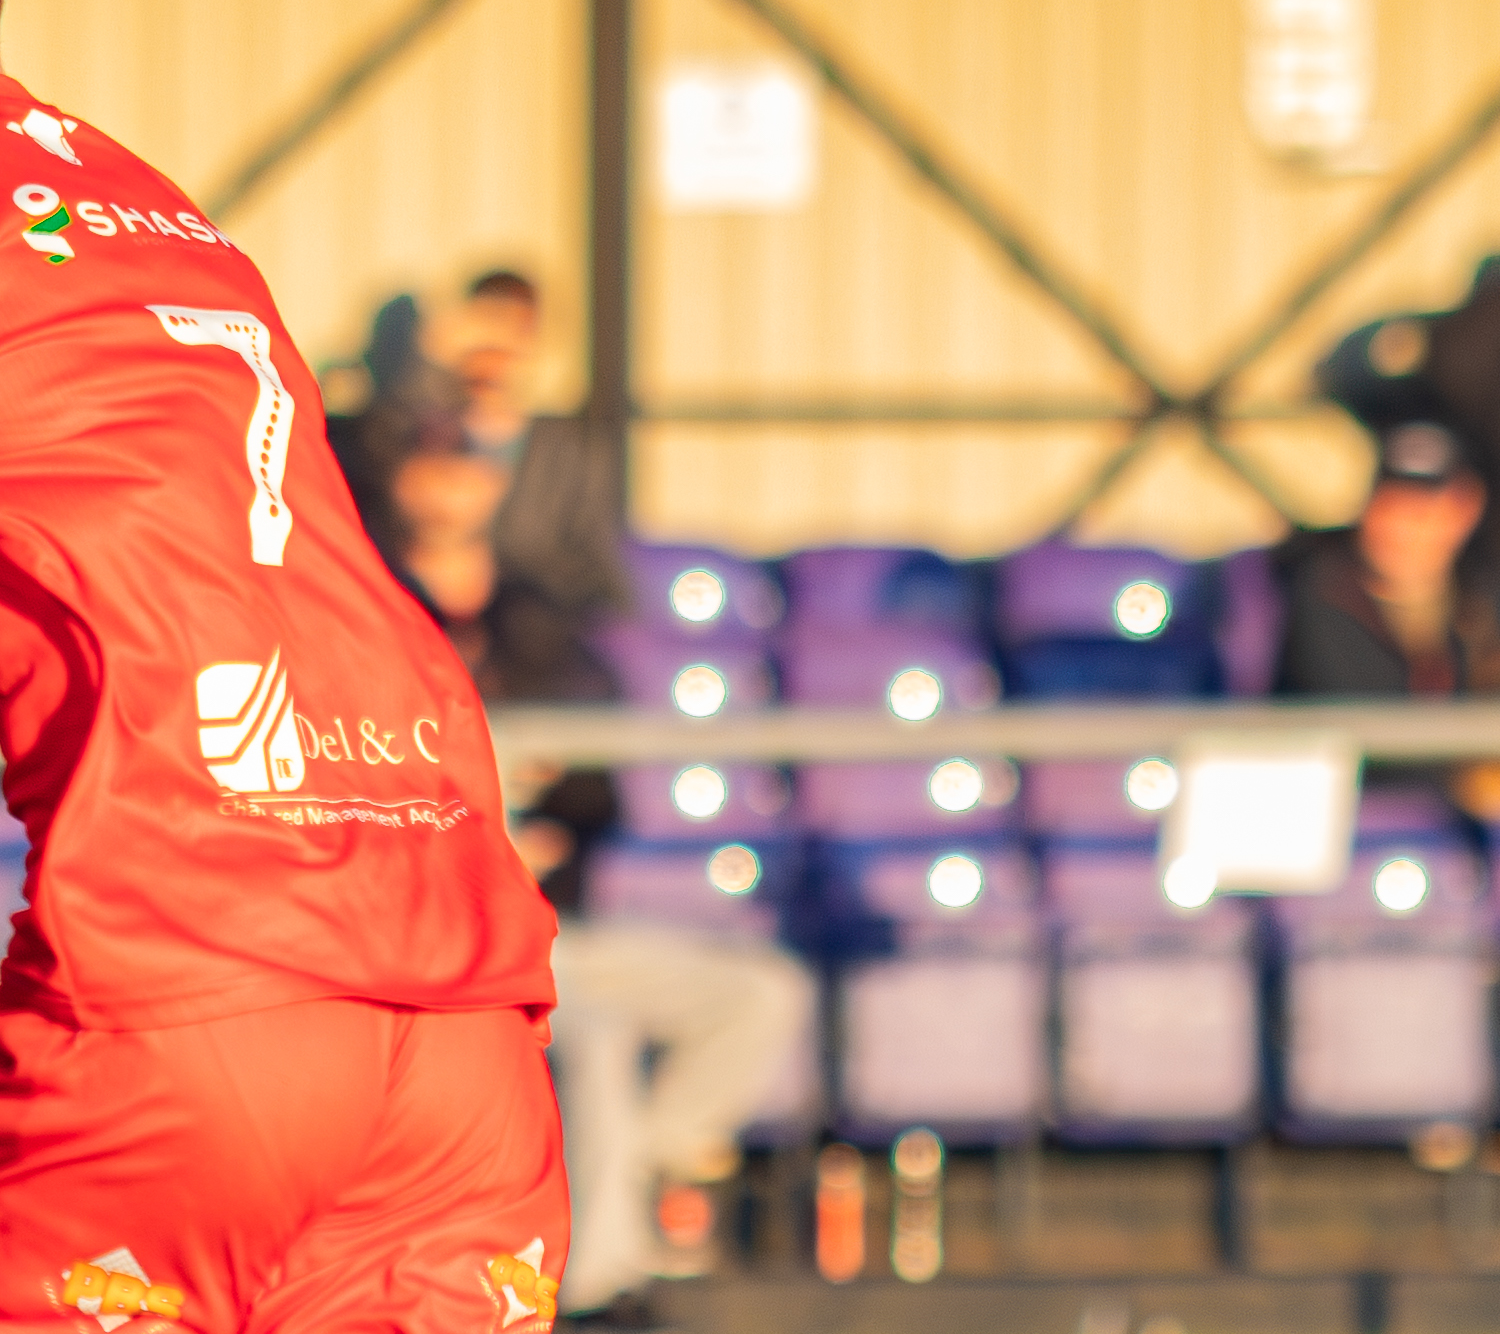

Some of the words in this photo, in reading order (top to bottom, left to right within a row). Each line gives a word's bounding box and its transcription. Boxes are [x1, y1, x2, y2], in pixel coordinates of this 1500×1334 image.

[144, 304, 295, 567] 7
[294, 712, 357, 762] Del
[360, 719, 405, 765] &
